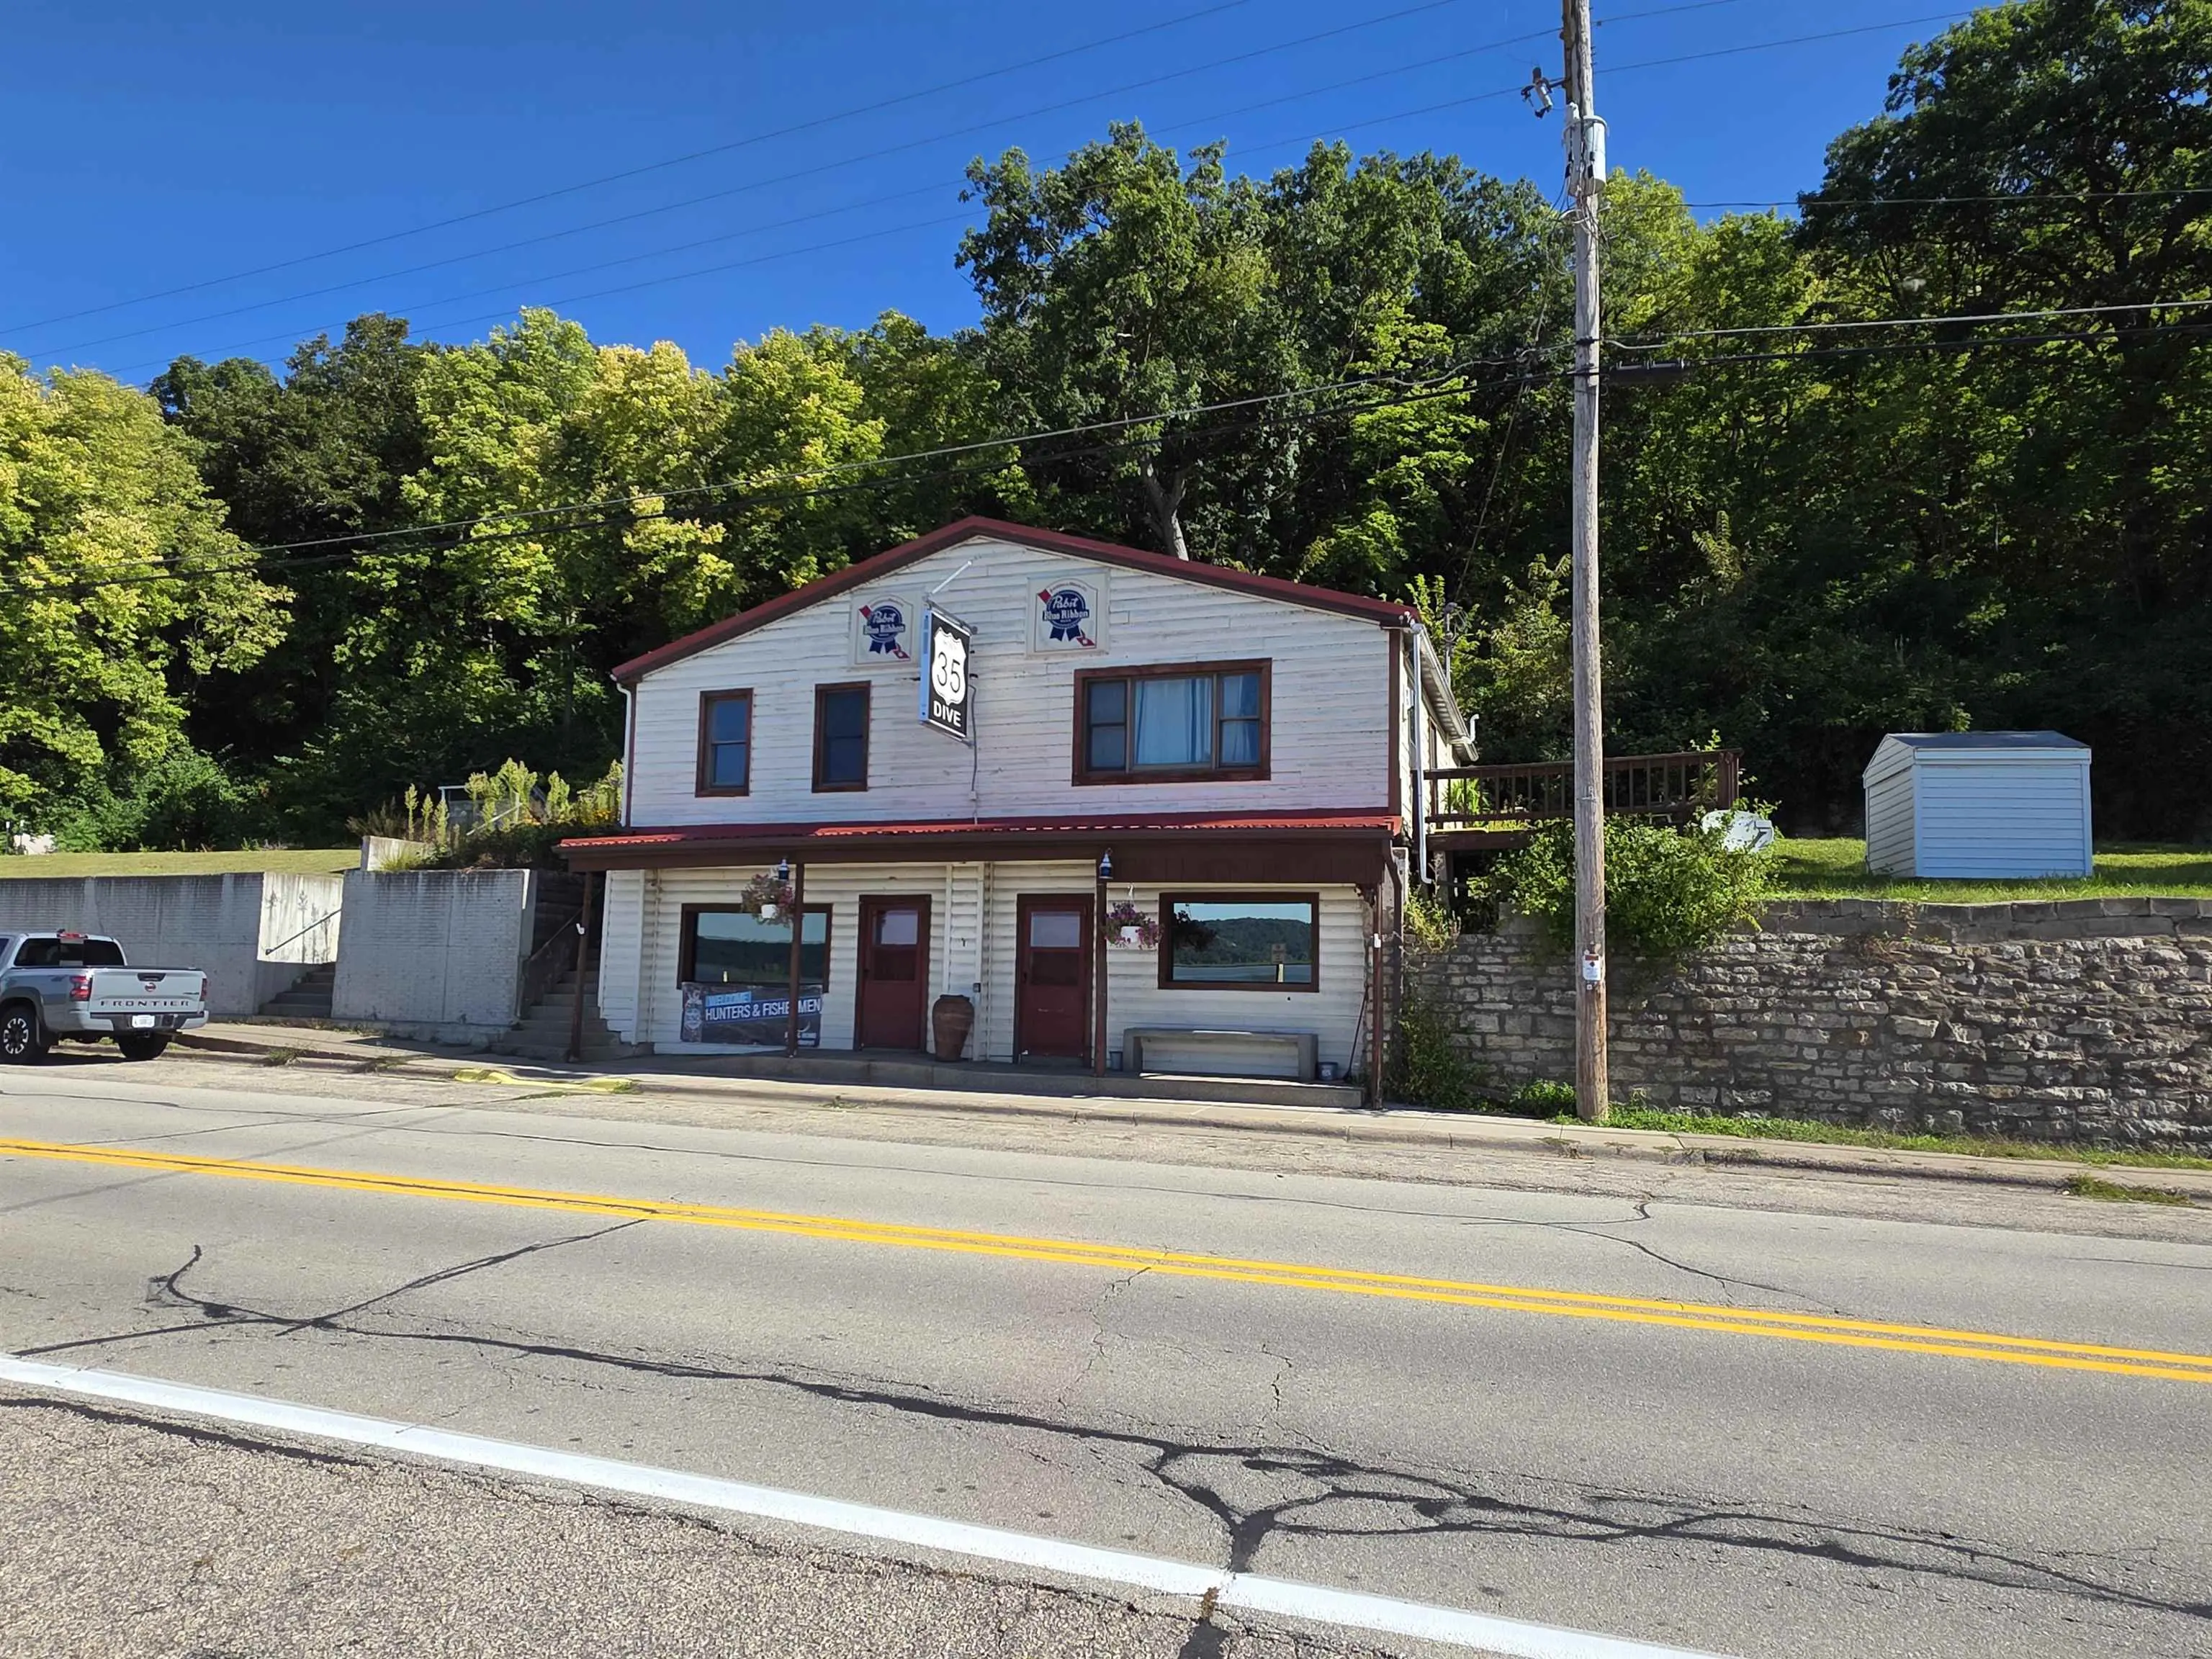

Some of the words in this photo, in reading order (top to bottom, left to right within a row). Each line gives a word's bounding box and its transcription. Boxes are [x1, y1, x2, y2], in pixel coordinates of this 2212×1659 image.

[1053, 595, 1079, 609] Pabst
[1061, 608, 1089, 619] Ribbon
[938, 652, 961, 693] 35
[933, 701, 962, 727] DIVE
[706, 1004, 750, 1020] HUNTERS
[752, 1004, 760, 1017] &
[763, 999, 821, 1016] FISHEMEN
